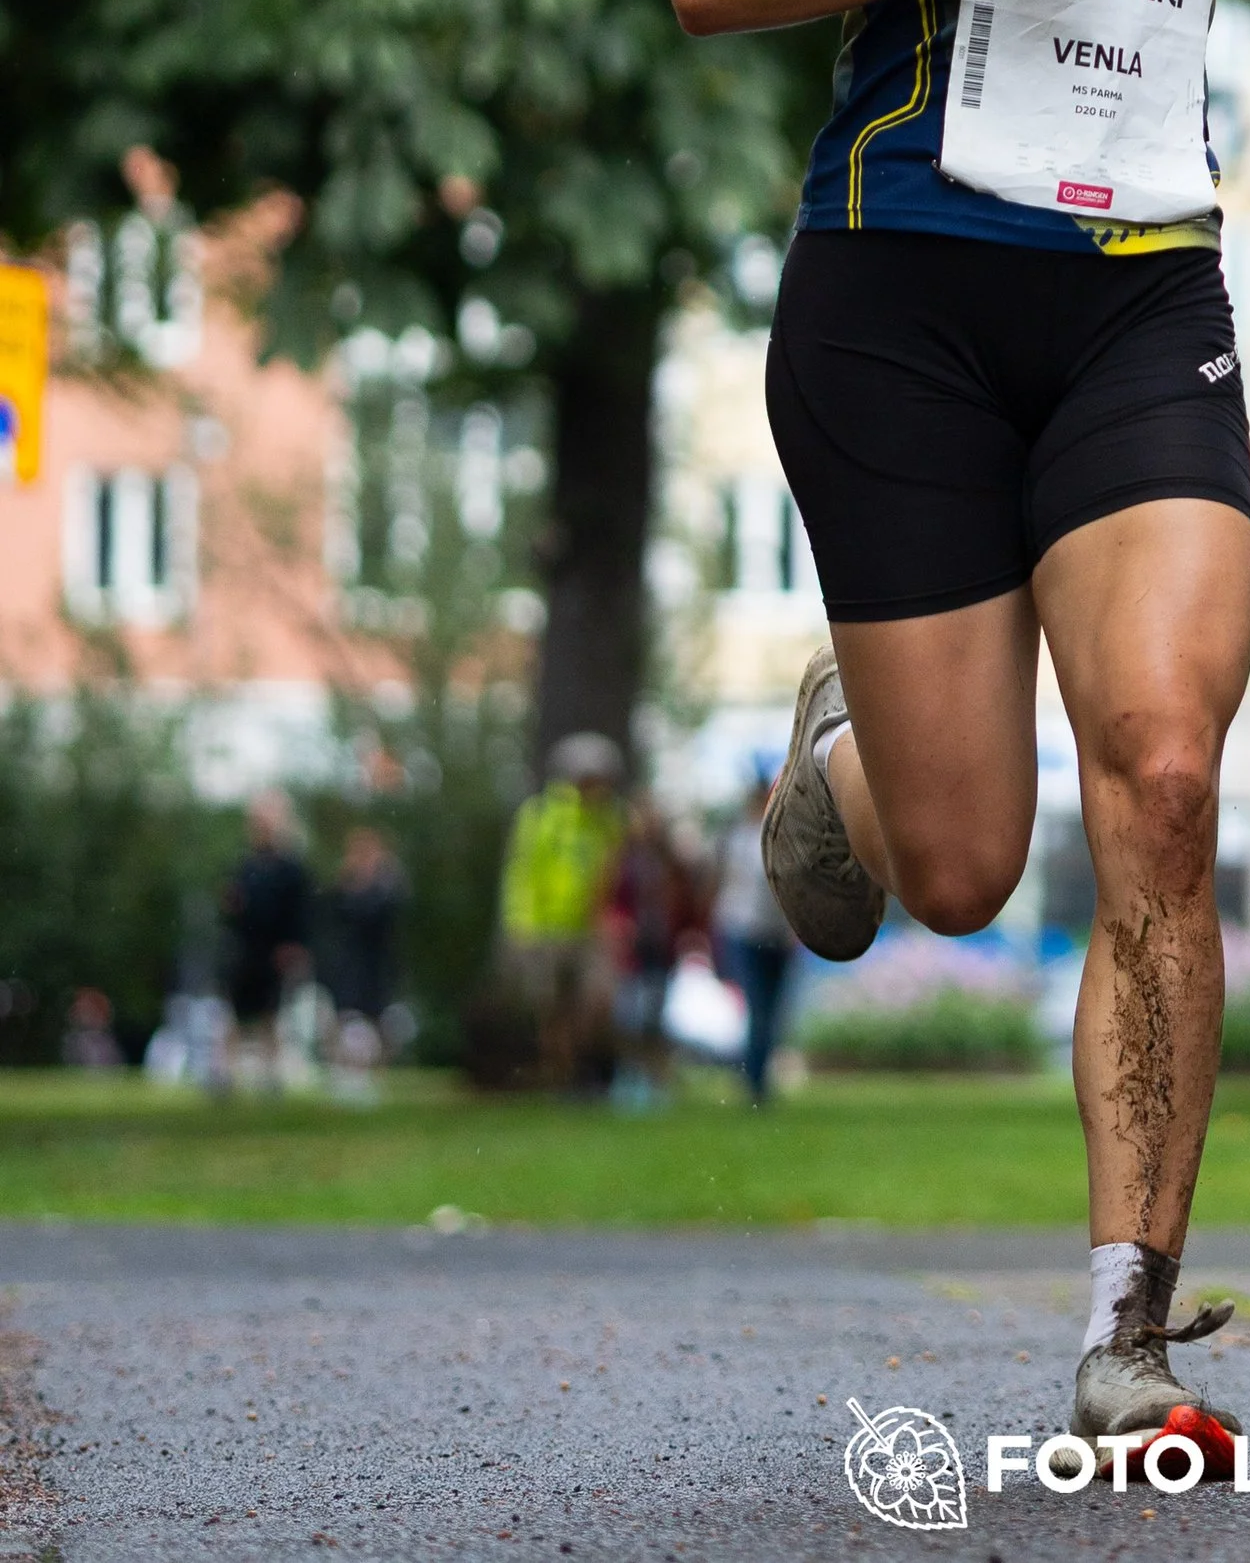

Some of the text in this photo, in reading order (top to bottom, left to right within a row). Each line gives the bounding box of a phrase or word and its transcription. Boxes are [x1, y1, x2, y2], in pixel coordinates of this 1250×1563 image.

[1053, 37, 1143, 78] VENLA
[1072, 84, 1123, 101] MS PARMA
[1075, 104, 1117, 119] D20 ELIT
